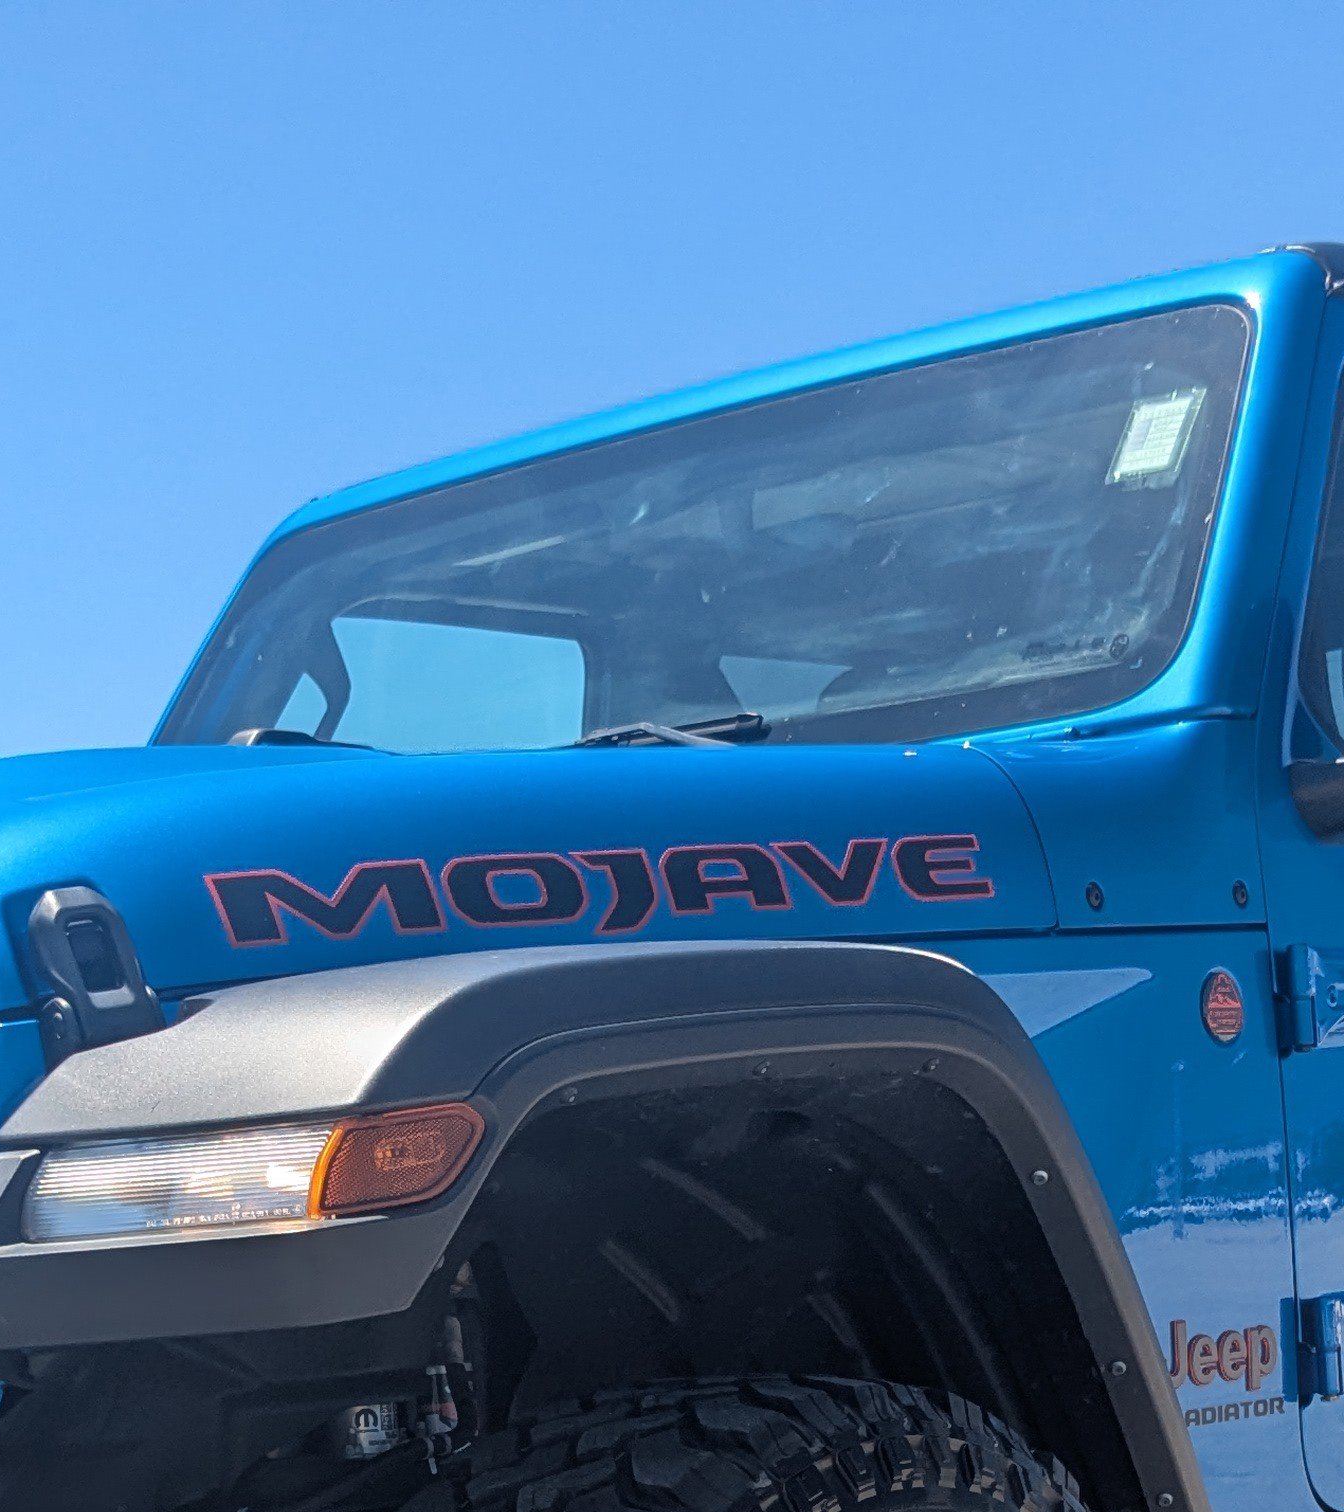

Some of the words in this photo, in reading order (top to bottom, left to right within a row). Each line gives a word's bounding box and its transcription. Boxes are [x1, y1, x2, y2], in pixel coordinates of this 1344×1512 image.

[203, 833, 995, 948] MOJAVE
[1169, 1318, 1278, 1392] Jeep
[1183, 1396, 1285, 1427] ADIATOR
